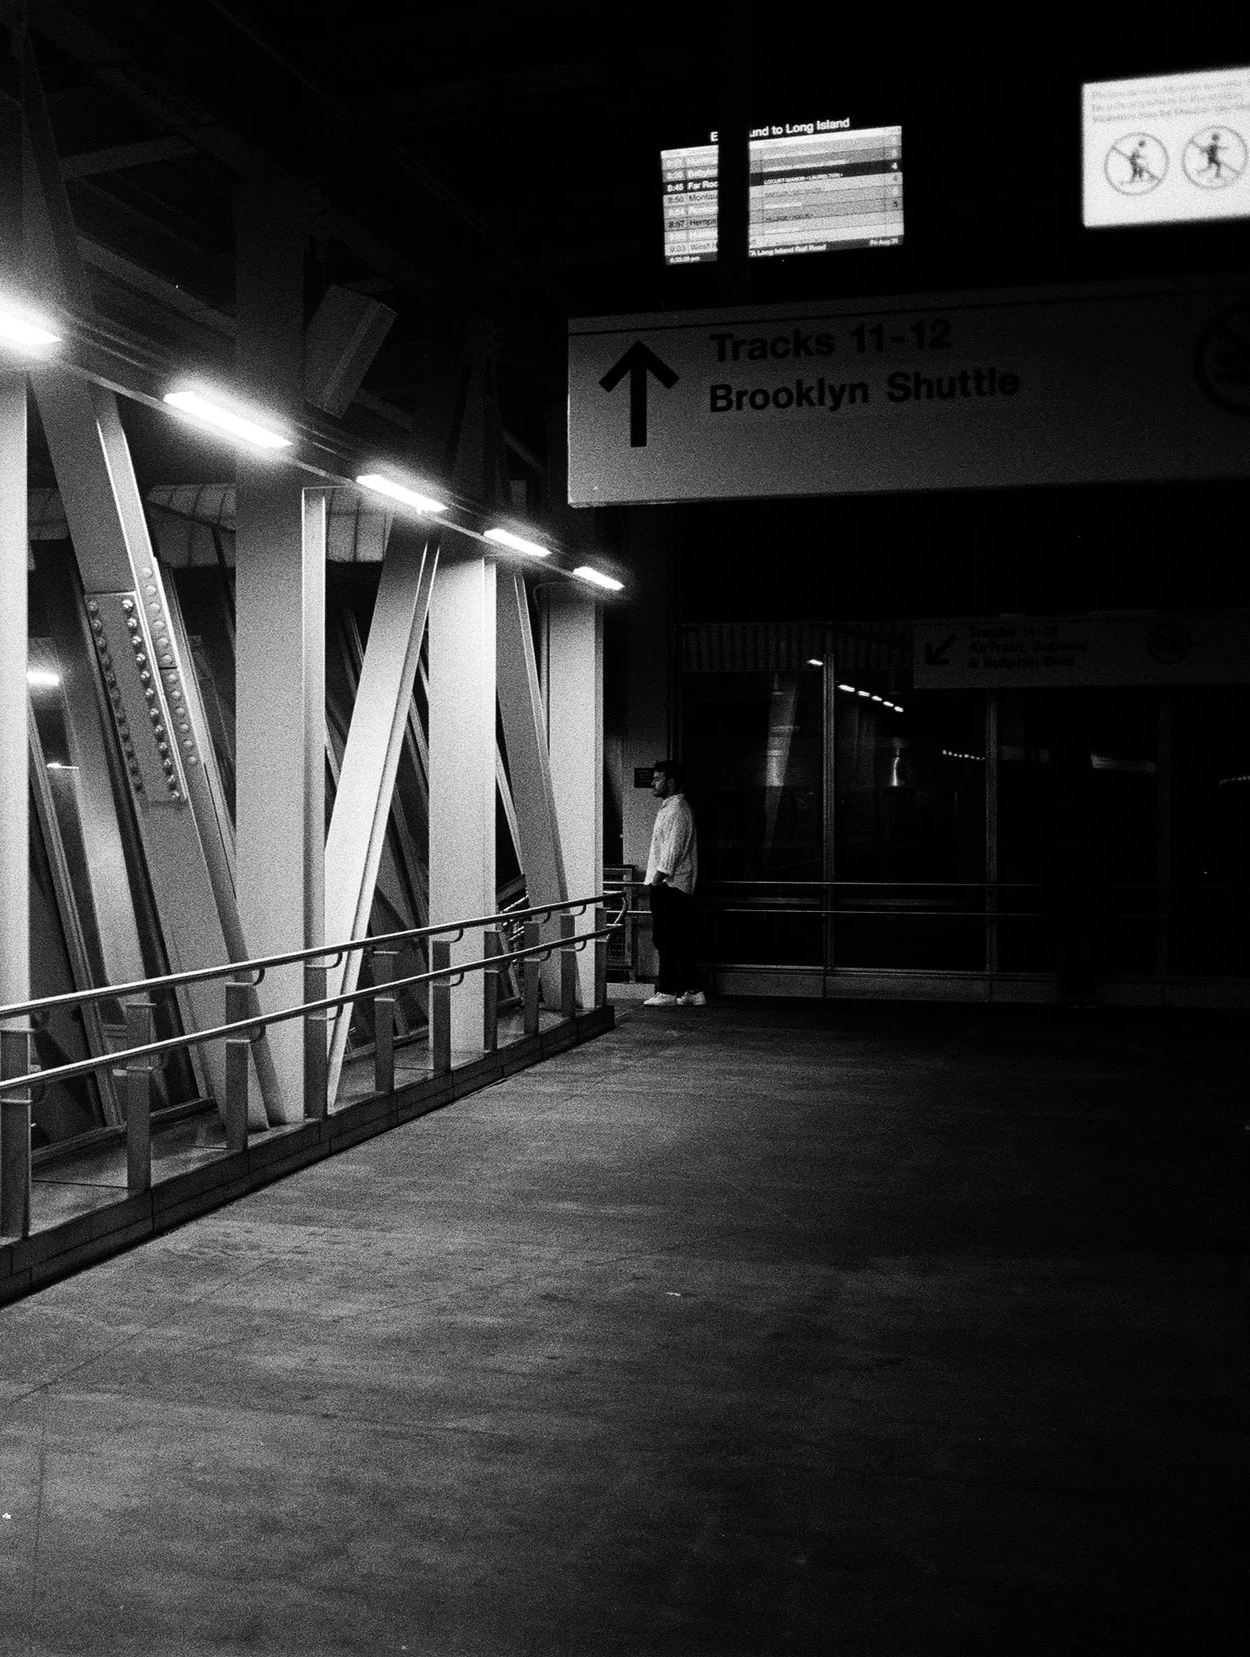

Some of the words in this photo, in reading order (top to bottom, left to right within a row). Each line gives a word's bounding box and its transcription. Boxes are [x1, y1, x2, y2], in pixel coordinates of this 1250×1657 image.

[772, 124, 783, 135] to
[785, 122, 814, 134] Long
[816, 117, 850, 130] Island
[891, 162, 898, 170] 4
[667, 183, 684, 192] 8:45
[687, 181, 702, 191] Far
[710, 325, 836, 361] Tracks
[850, 319, 952, 353] 11-12
[710, 377, 869, 412] Brooklyn
[887, 367, 1020, 402] Shuttle
[970, 626, 1015, 638] Tracks
[983, 656, 1039, 671] Sutphin
[1044, 655, 1076, 667] Blvd
